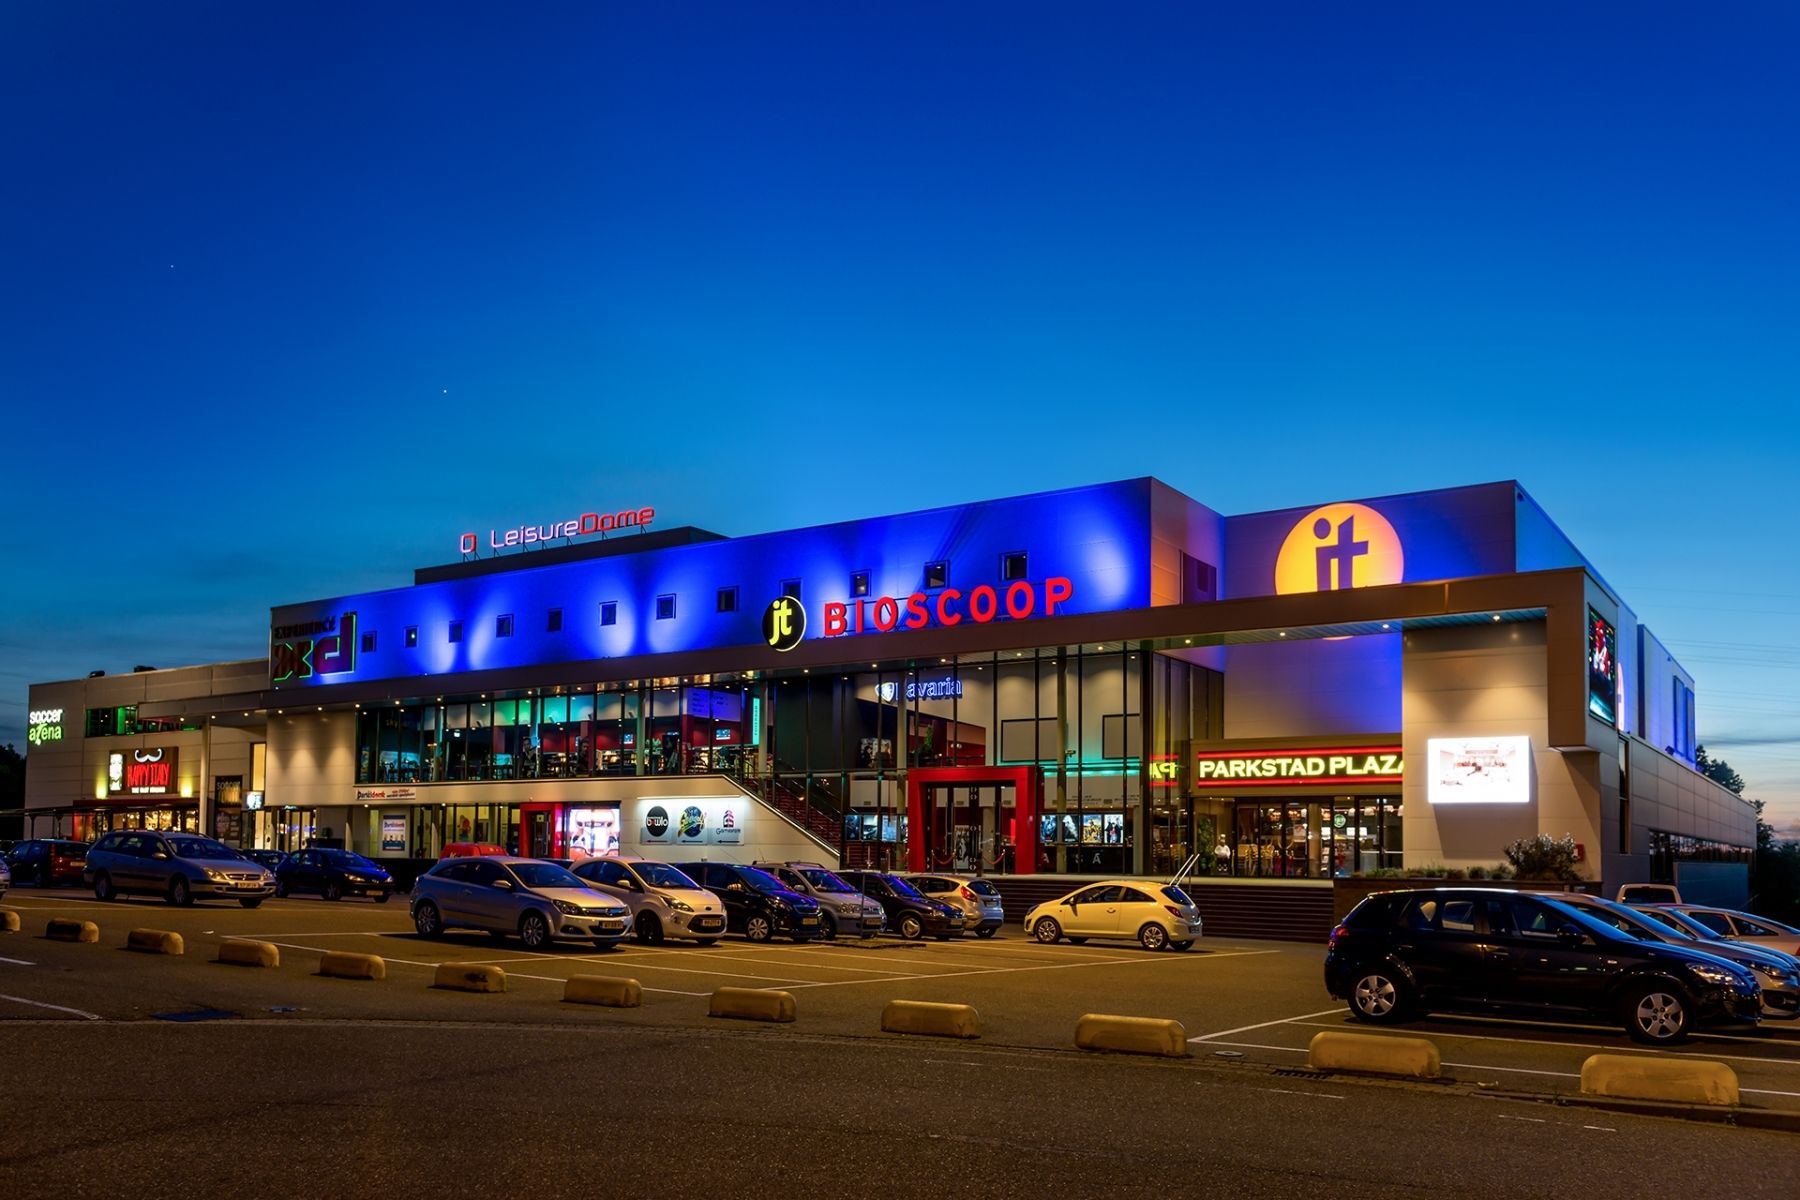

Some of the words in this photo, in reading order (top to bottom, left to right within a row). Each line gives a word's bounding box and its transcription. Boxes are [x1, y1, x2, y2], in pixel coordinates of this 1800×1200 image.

[491, 507, 655, 548] LeisureDome
[823, 577, 1074, 637] BIOSCOOP
[769, 600, 793, 646] jt
[29, 708, 64, 725] soccer
[28, 722, 63, 746] arena
[127, 763, 150, 788] HAPPY
[1199, 757, 1325, 779] PARKSTAD
[1328, 754, 1404, 777] PLAZ
